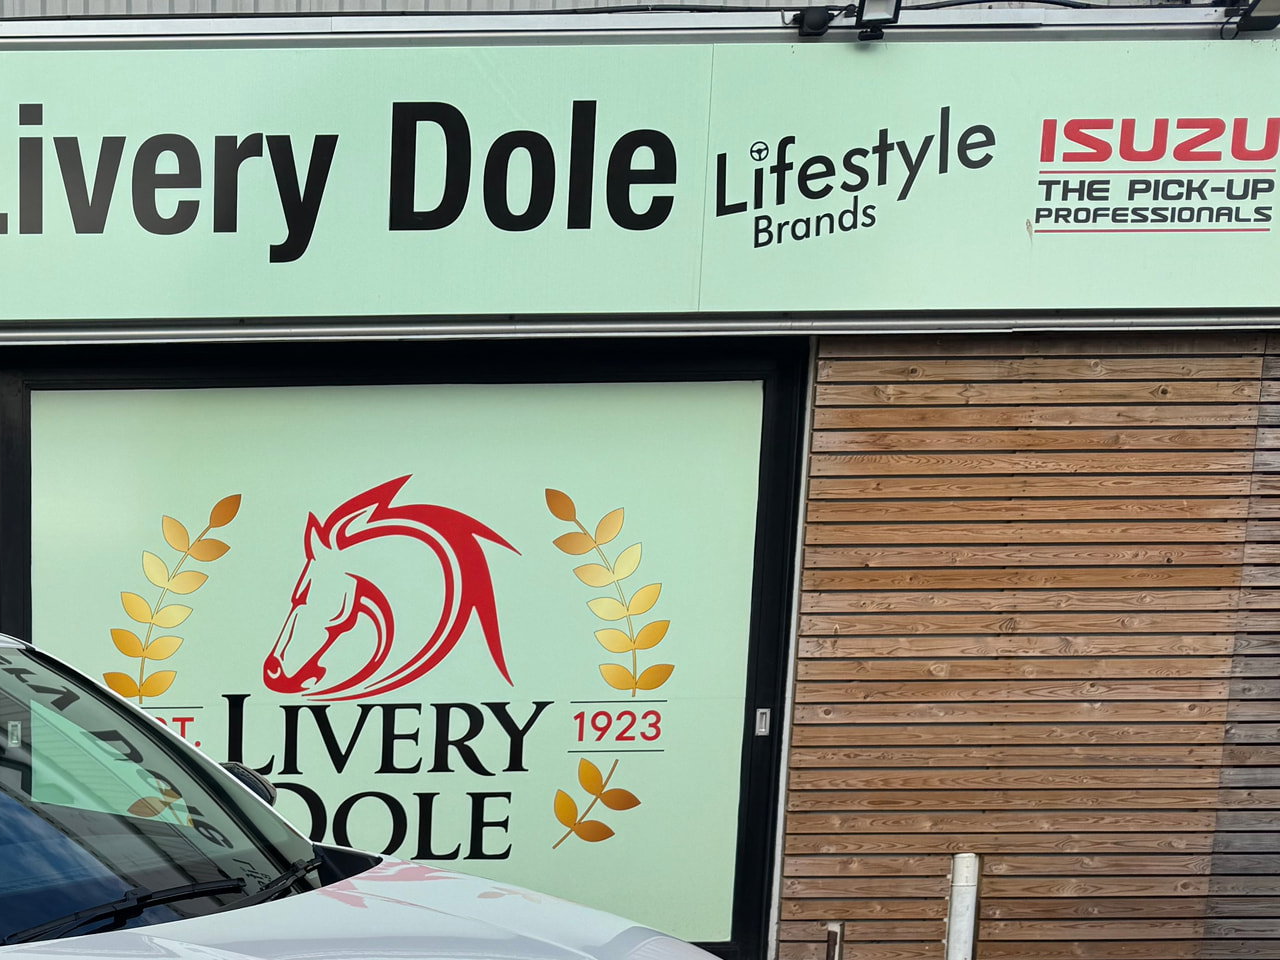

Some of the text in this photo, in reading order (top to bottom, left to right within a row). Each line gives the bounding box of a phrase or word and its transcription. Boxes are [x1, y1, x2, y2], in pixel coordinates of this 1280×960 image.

[388, 99, 678, 233] Dole
[716, 106, 996, 218] Lifestyle
[1039, 117, 1280, 162] ISUZU
[1034, 206, 1273, 224] PROFESSIONALS
[1038, 178, 1275, 201] THE PICK-UP
[753, 195, 877, 248] Brands
[155, 693, 663, 776] T. LIVERY 1923
